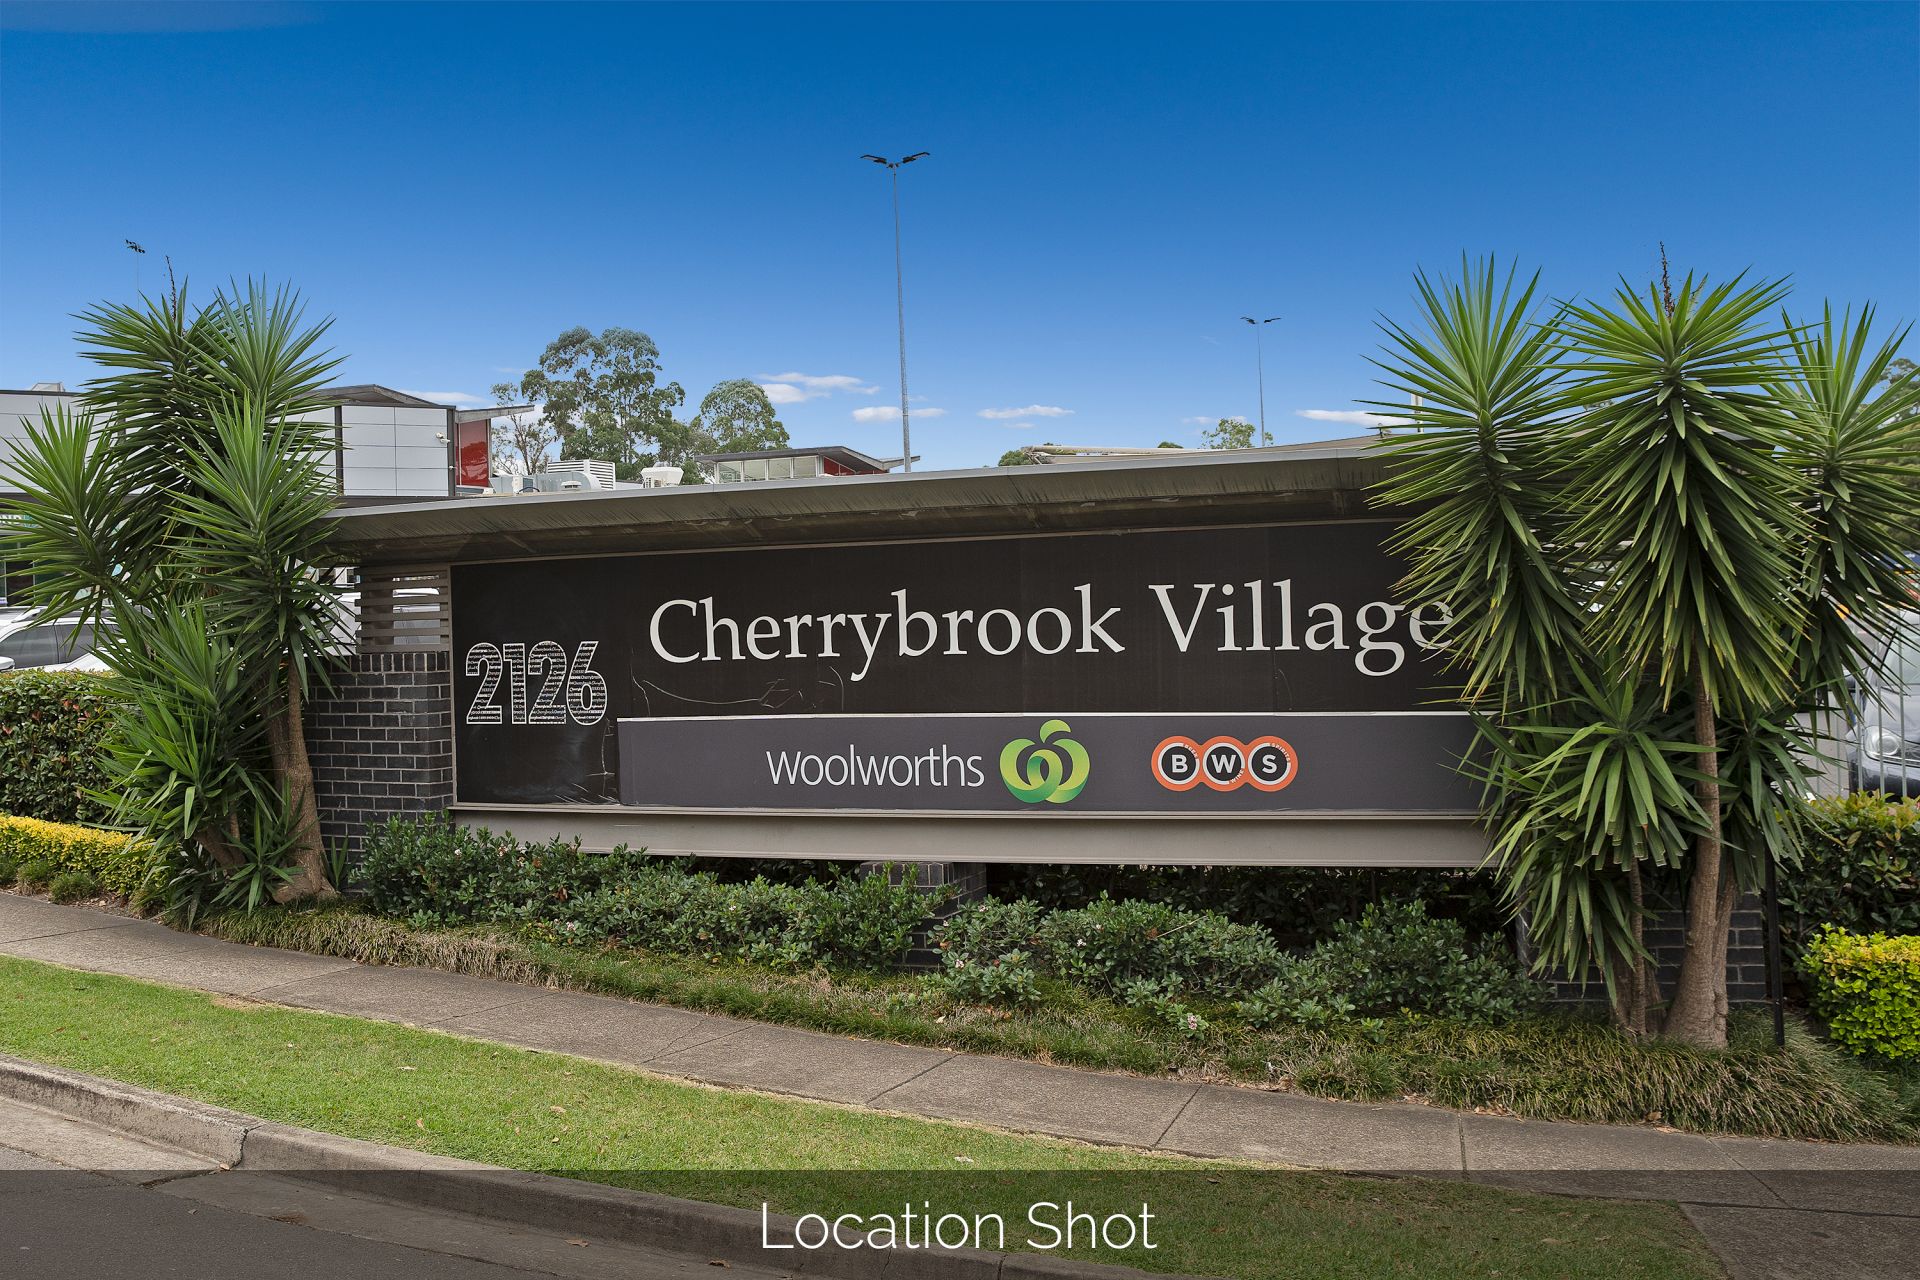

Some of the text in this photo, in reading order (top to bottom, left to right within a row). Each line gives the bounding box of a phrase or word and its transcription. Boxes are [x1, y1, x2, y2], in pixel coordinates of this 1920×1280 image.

[649, 578, 1454, 682] Cherrybrook Village
[465, 640, 608, 726] 2126
[765, 743, 985, 788] Woolworths
[1171, 754, 1278, 774] BWS
